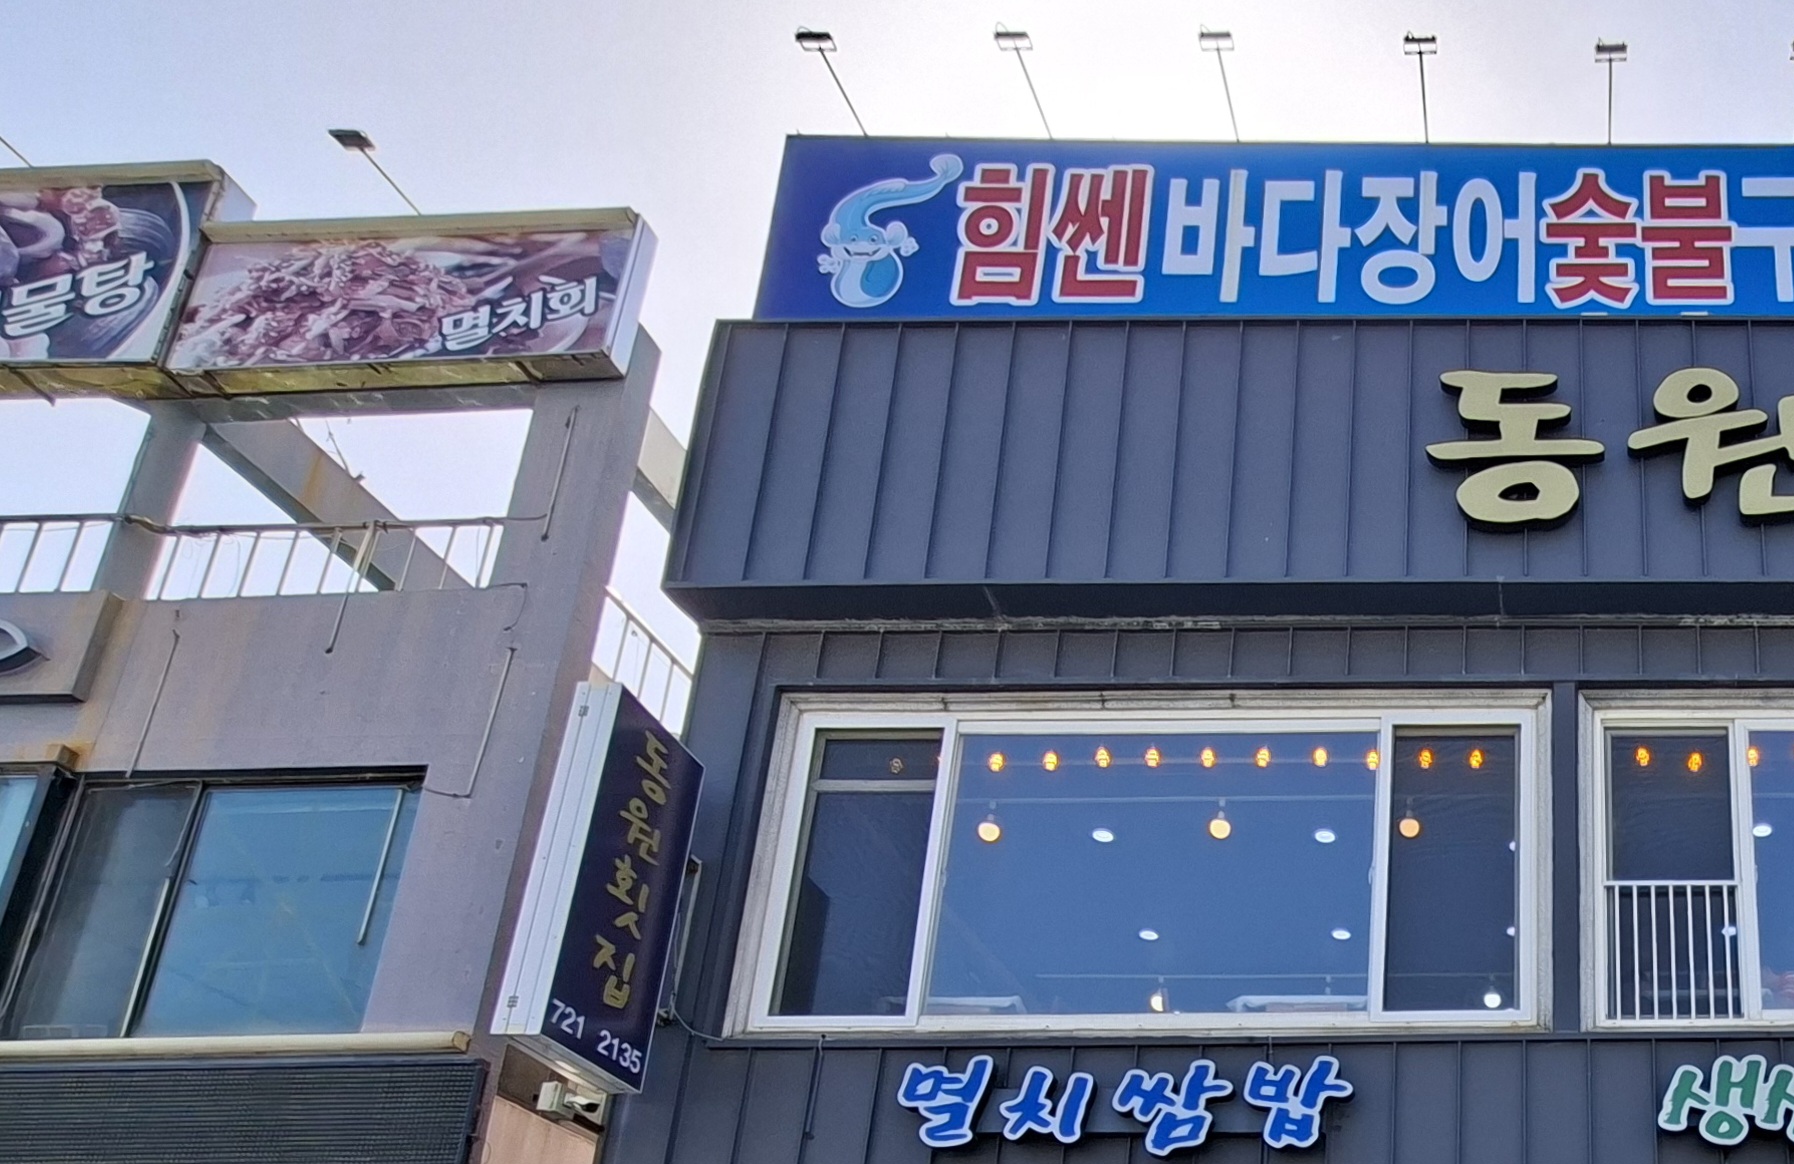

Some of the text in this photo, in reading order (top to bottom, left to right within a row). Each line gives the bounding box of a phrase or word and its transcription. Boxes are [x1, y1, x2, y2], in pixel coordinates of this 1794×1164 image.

[439, 275, 600, 354] 멸치회
[591, 729, 671, 1010] 동원횟집
[550, 998, 644, 1075] 721 2135
